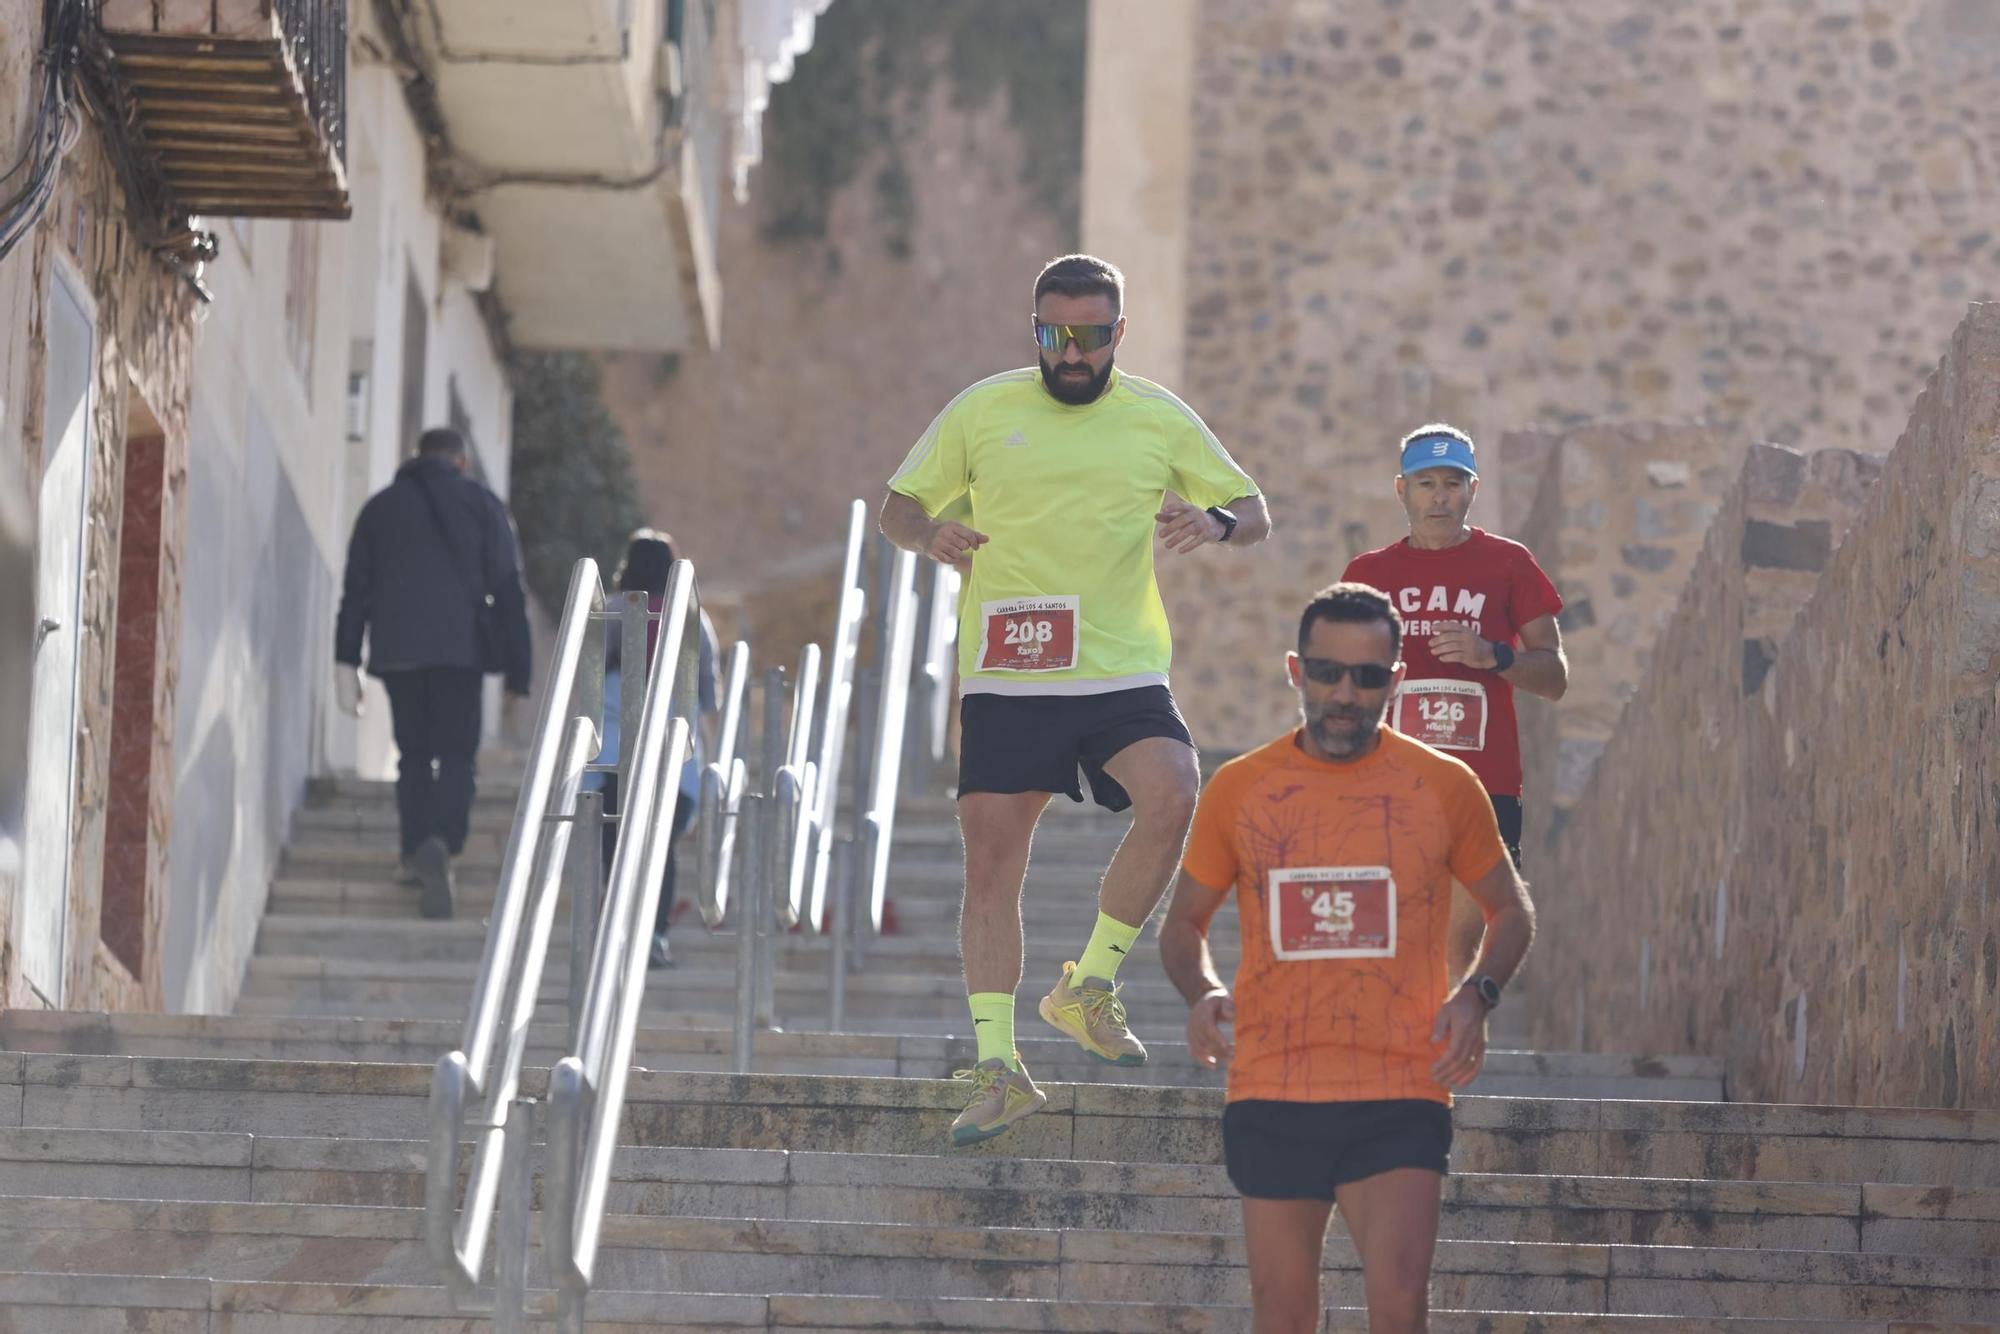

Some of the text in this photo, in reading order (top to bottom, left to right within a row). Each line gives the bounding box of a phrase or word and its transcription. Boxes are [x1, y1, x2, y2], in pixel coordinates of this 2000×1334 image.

[1385, 585, 1486, 619] CAM
[1004, 620, 1053, 645] 208
[1420, 698, 1465, 721] 126
[1311, 891, 1356, 917] 45
